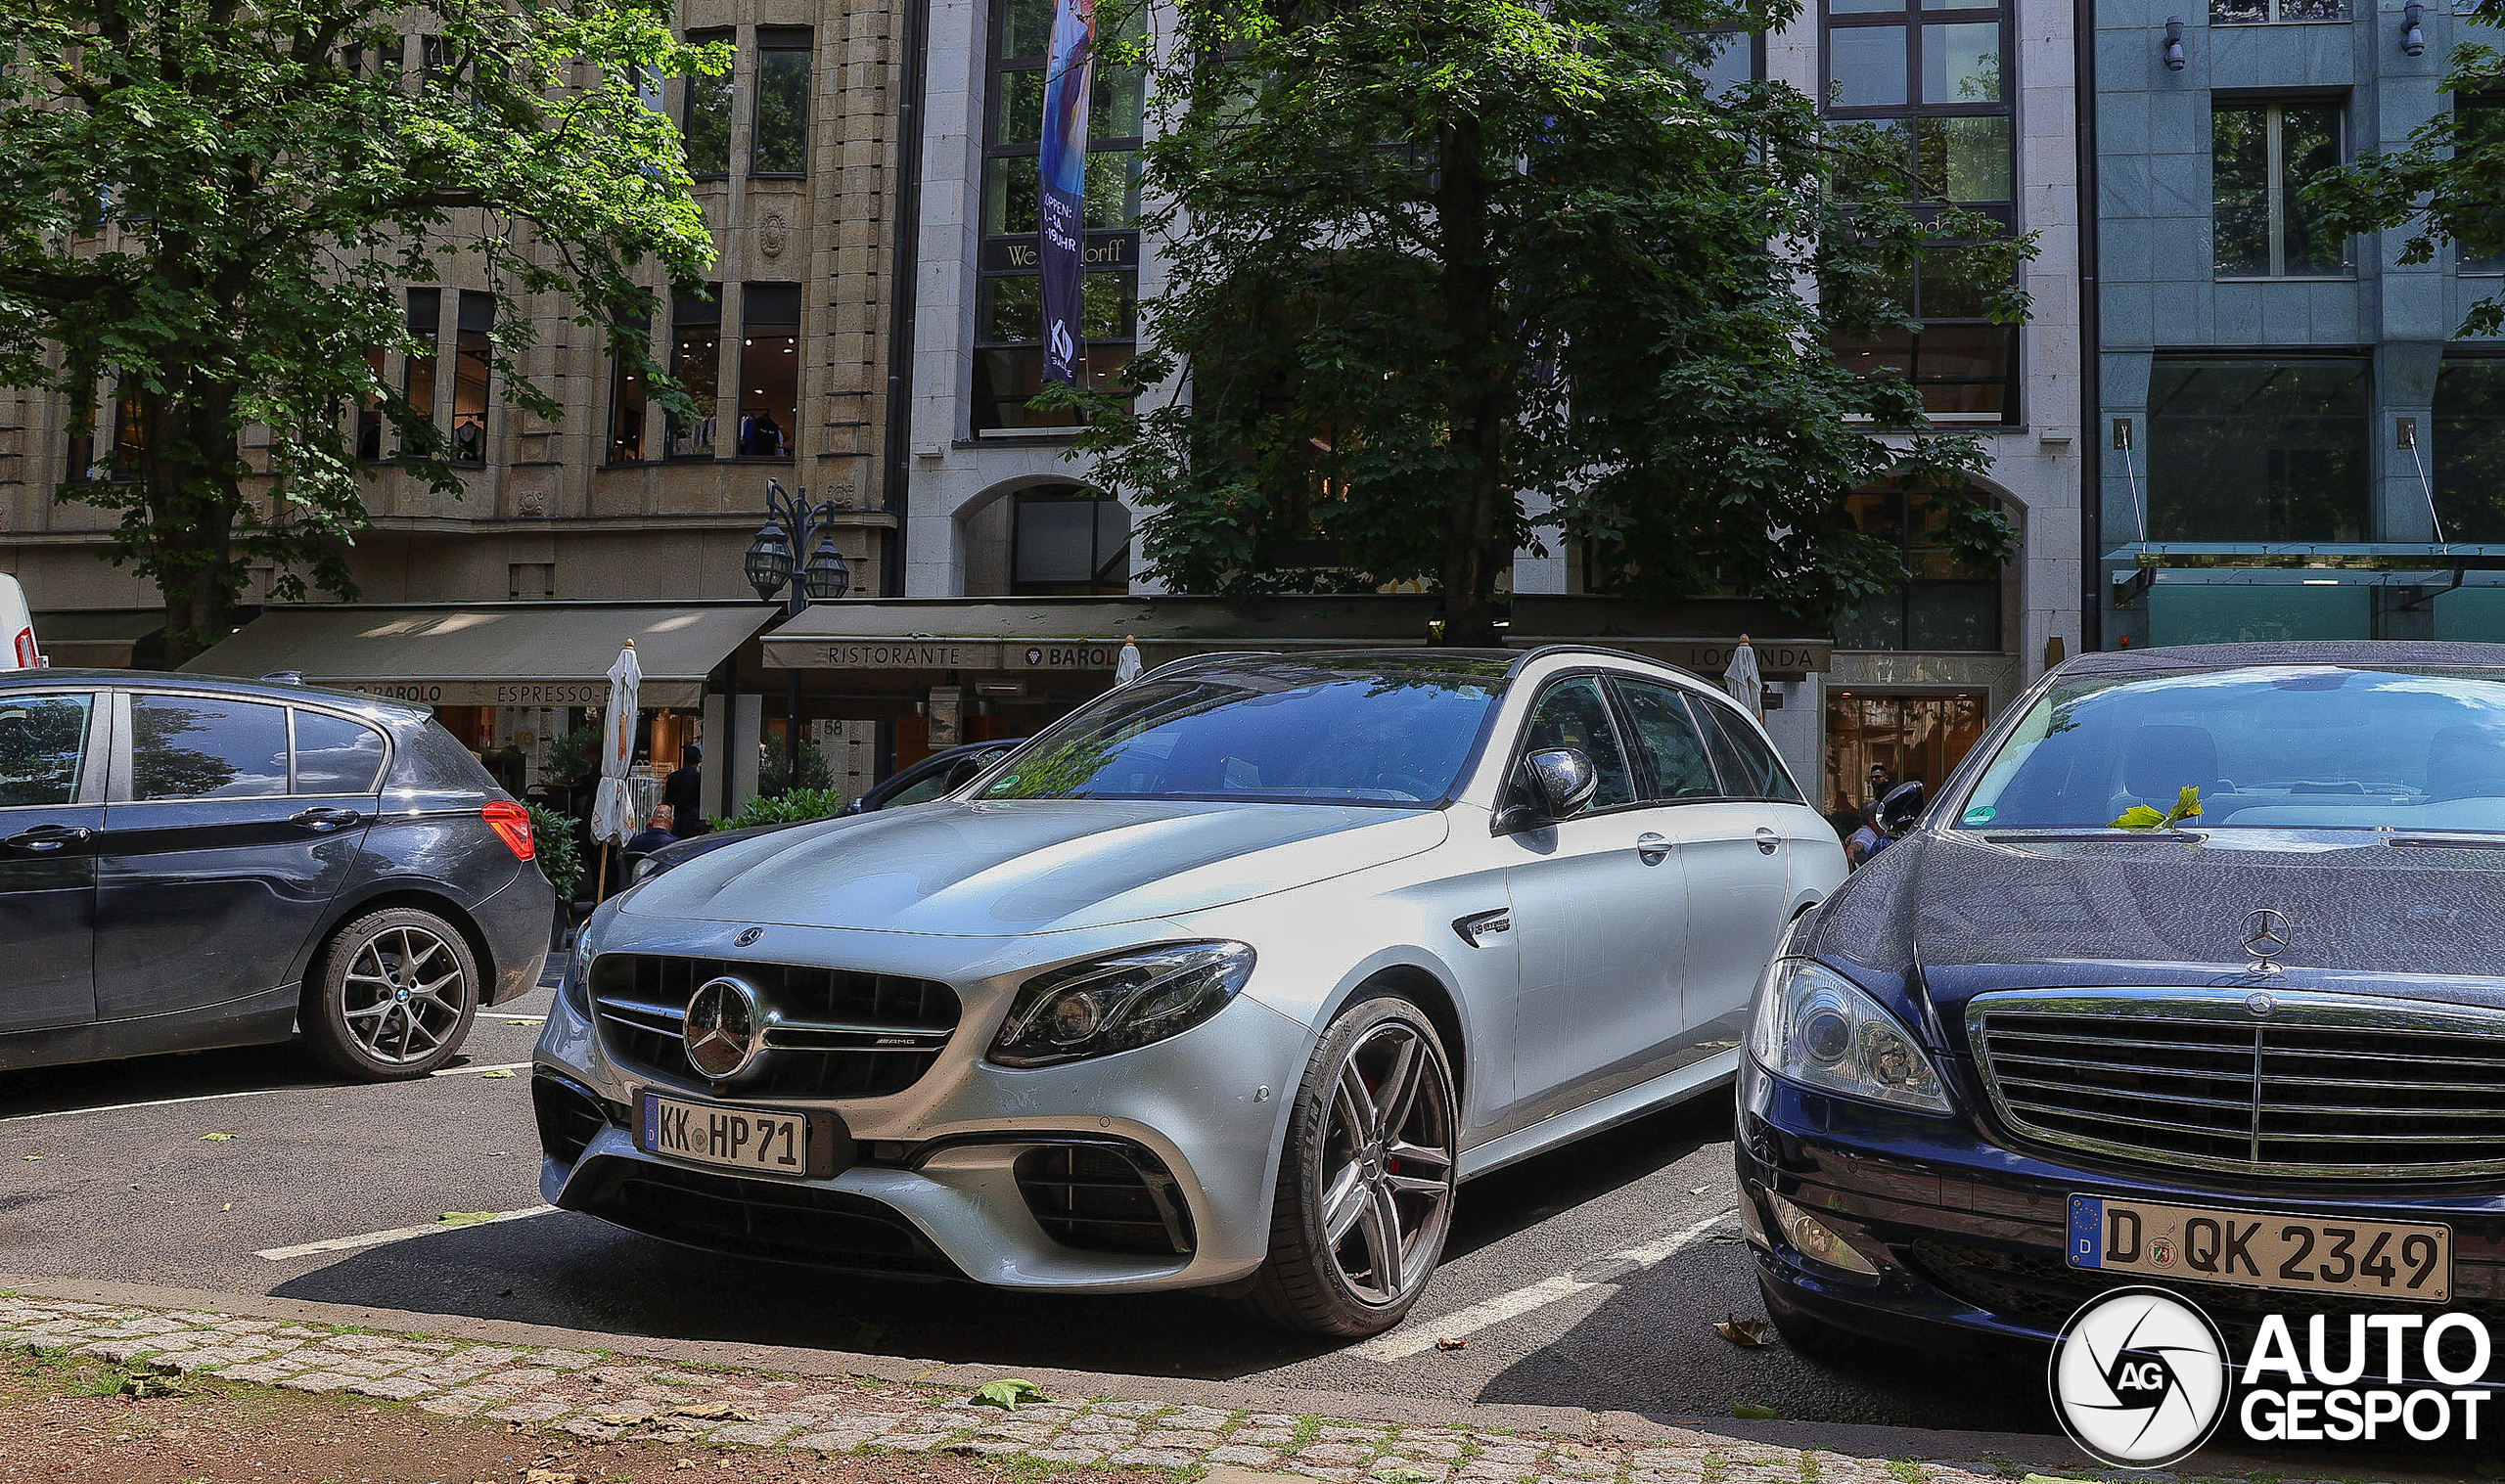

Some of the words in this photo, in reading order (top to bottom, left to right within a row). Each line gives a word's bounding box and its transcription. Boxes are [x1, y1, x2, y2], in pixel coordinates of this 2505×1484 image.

[829, 647, 960, 665] RISTORANTE
[1050, 649, 1116, 666] BAROL
[1691, 648, 1814, 667] LOCNDA
[373, 686, 441, 702] BAROLO
[823, 720, 843, 735] 58
[660, 1104, 690, 1152] KK
[709, 1113, 750, 1159] HP
[756, 1119, 797, 1166] 71
[2079, 1237, 2091, 1254] D
[2107, 1207, 2142, 1263] D
[2184, 1217, 2262, 1277] QK
[2279, 1225, 2439, 1290] 2349
